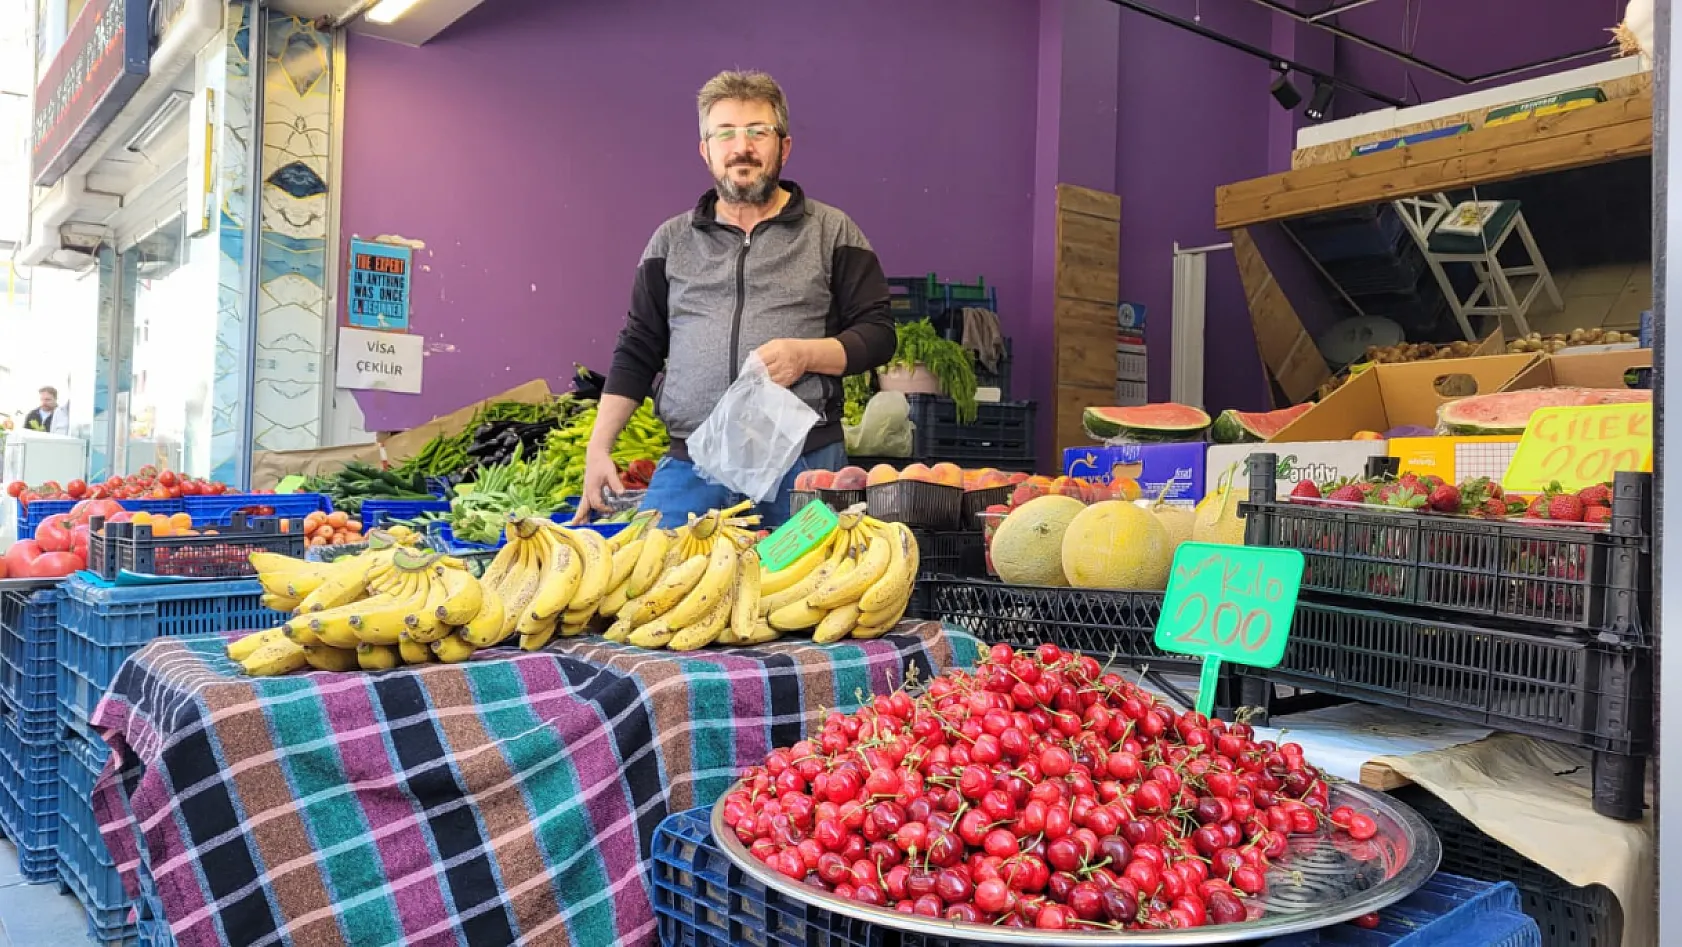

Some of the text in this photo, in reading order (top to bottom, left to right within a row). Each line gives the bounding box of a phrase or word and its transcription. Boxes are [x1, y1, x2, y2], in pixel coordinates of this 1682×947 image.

[354, 285, 403, 302] WAS ONCE
[366, 340, 396, 355] VİSA
[356, 359, 403, 375] ÇEKİLİR
[1530, 444, 1642, 484] 200
[1221, 556, 1284, 603] Kilo
[1173, 593, 1273, 652] 200
